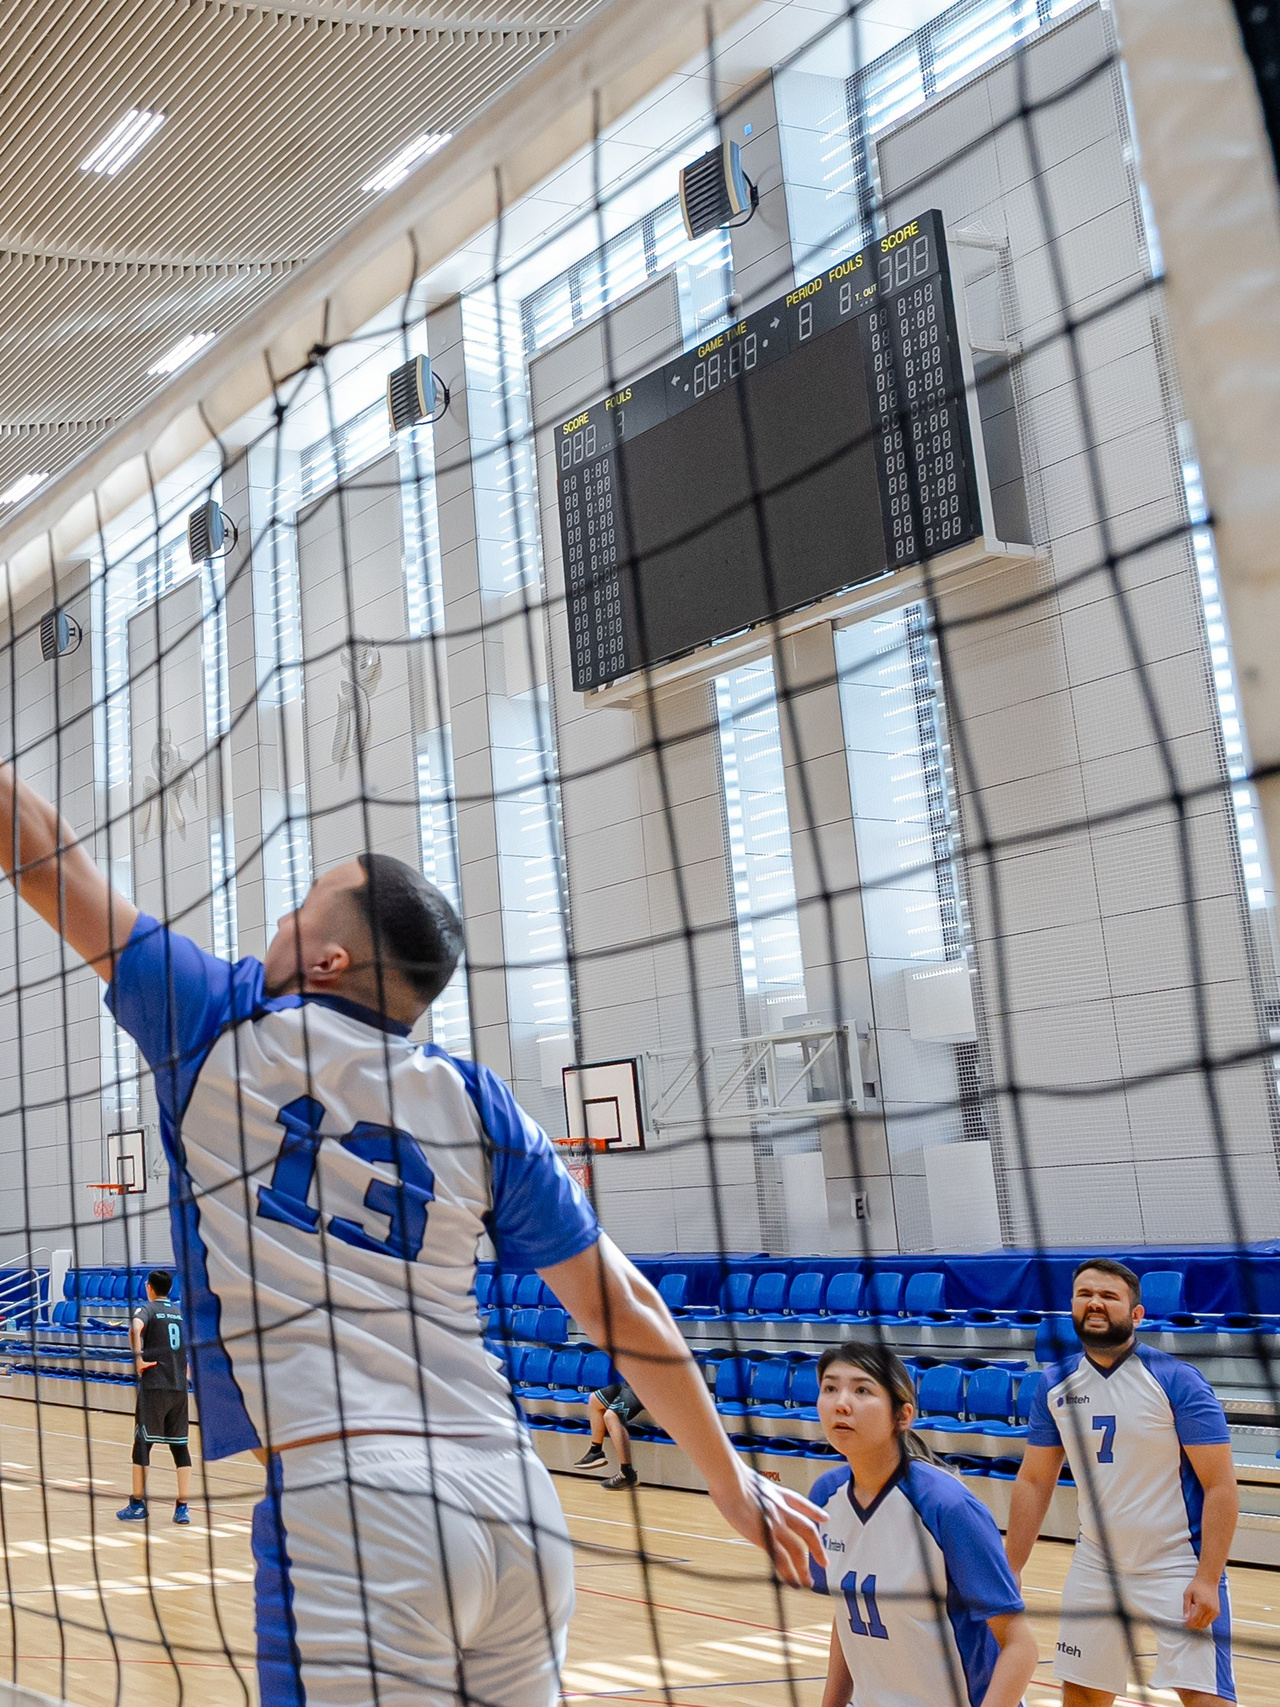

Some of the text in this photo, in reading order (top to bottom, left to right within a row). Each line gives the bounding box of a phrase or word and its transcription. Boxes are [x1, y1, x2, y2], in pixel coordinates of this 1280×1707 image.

[880, 220, 919, 253] SCORE
[829, 254, 863, 283] FOULS
[785, 278, 823, 308] PERIOD
[697, 320, 747, 358] GAME TME
[562, 411, 589, 435] SCORE
[256, 1094, 435, 1261] 13
[168, 1322, 181, 1351] 8
[1092, 1415, 1116, 1463] 7
[840, 1571, 889, 1640] 11
